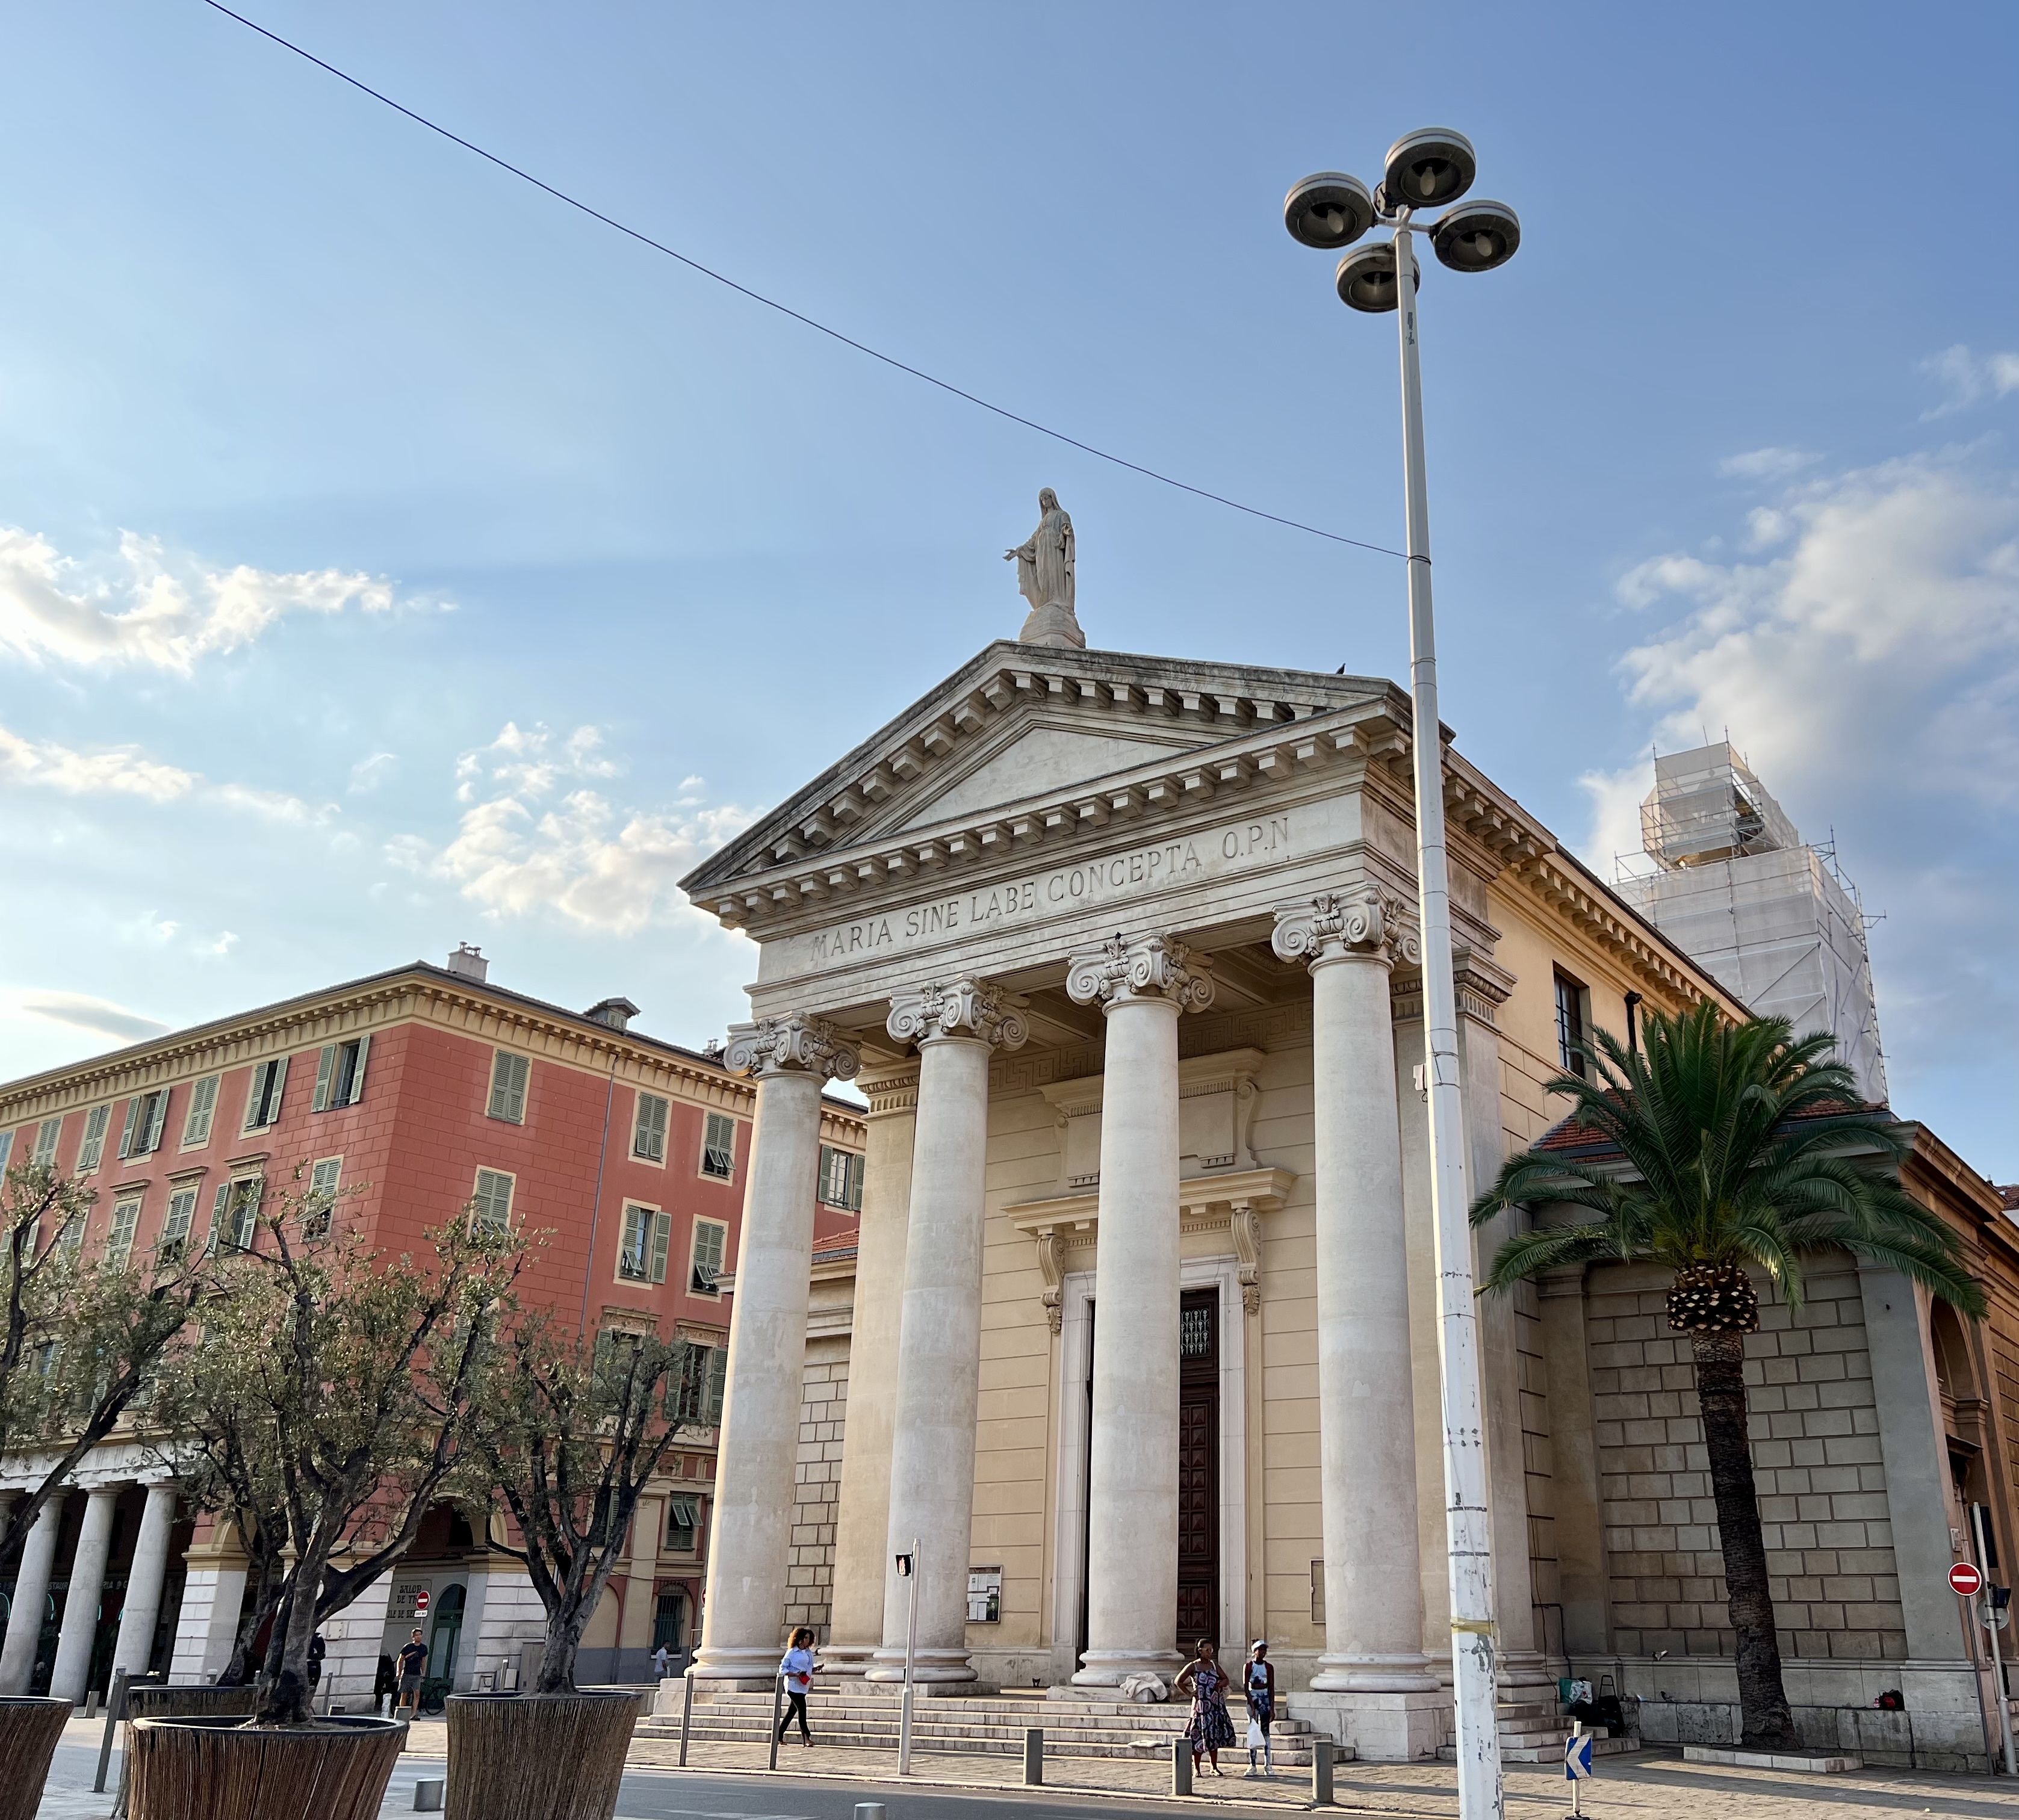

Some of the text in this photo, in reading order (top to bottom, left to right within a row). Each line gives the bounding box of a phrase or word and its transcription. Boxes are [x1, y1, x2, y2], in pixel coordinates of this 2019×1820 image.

[810, 918, 893, 961] MARIA
[905, 900, 959, 938] SINE
[970, 881, 1035, 923] LABE
[1047, 840, 1203, 902] CONCEPTA
[396, 1595, 405, 1603] DE
